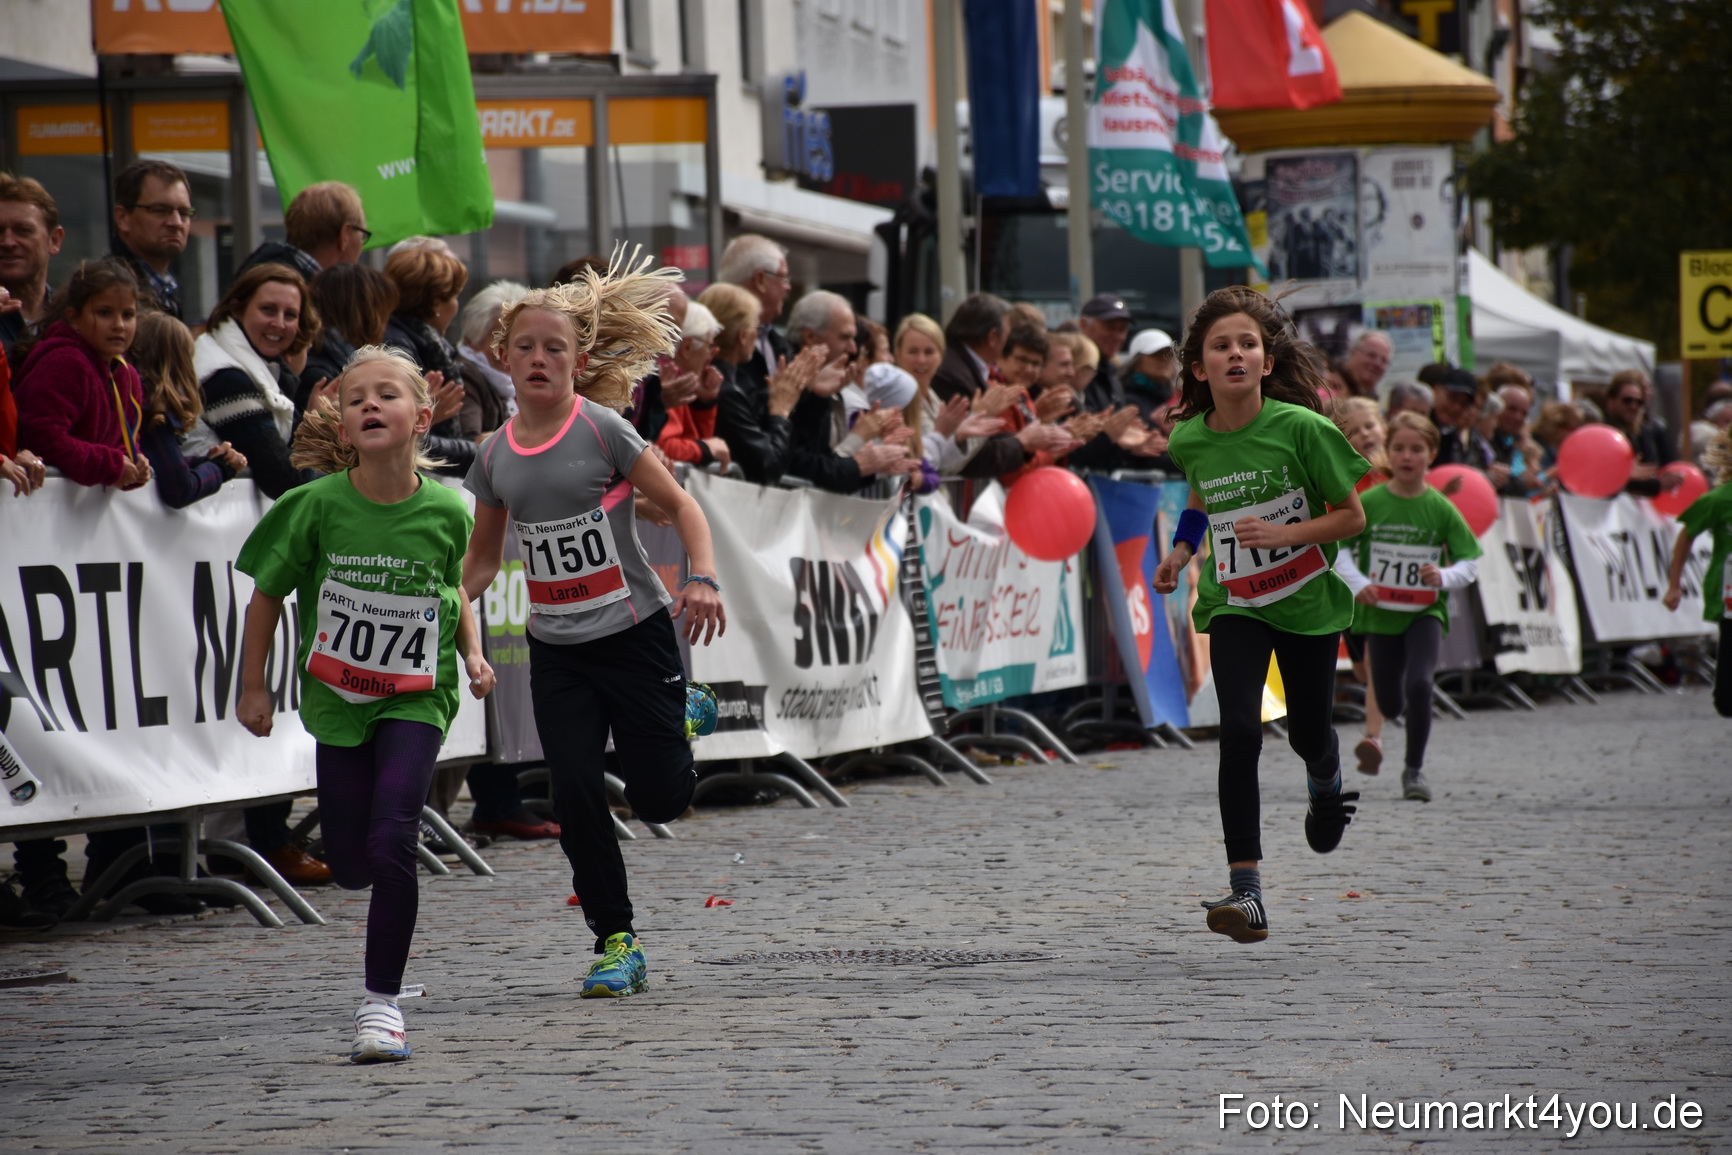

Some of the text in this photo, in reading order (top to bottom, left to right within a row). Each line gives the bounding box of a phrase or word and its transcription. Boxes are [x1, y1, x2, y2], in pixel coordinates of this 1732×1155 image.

[535, 516, 588, 534] Neumarkt
[1260, 506, 1290, 522] markt
[522, 528, 607, 576] 7150
[549, 582, 589, 602] Larah
[1249, 567, 1298, 594] Leonie
[322, 590, 420, 620] PARTL Neumarkt
[483, 569, 528, 627] BO
[330, 610, 427, 669] 7074
[341, 668, 396, 696] Sophia
